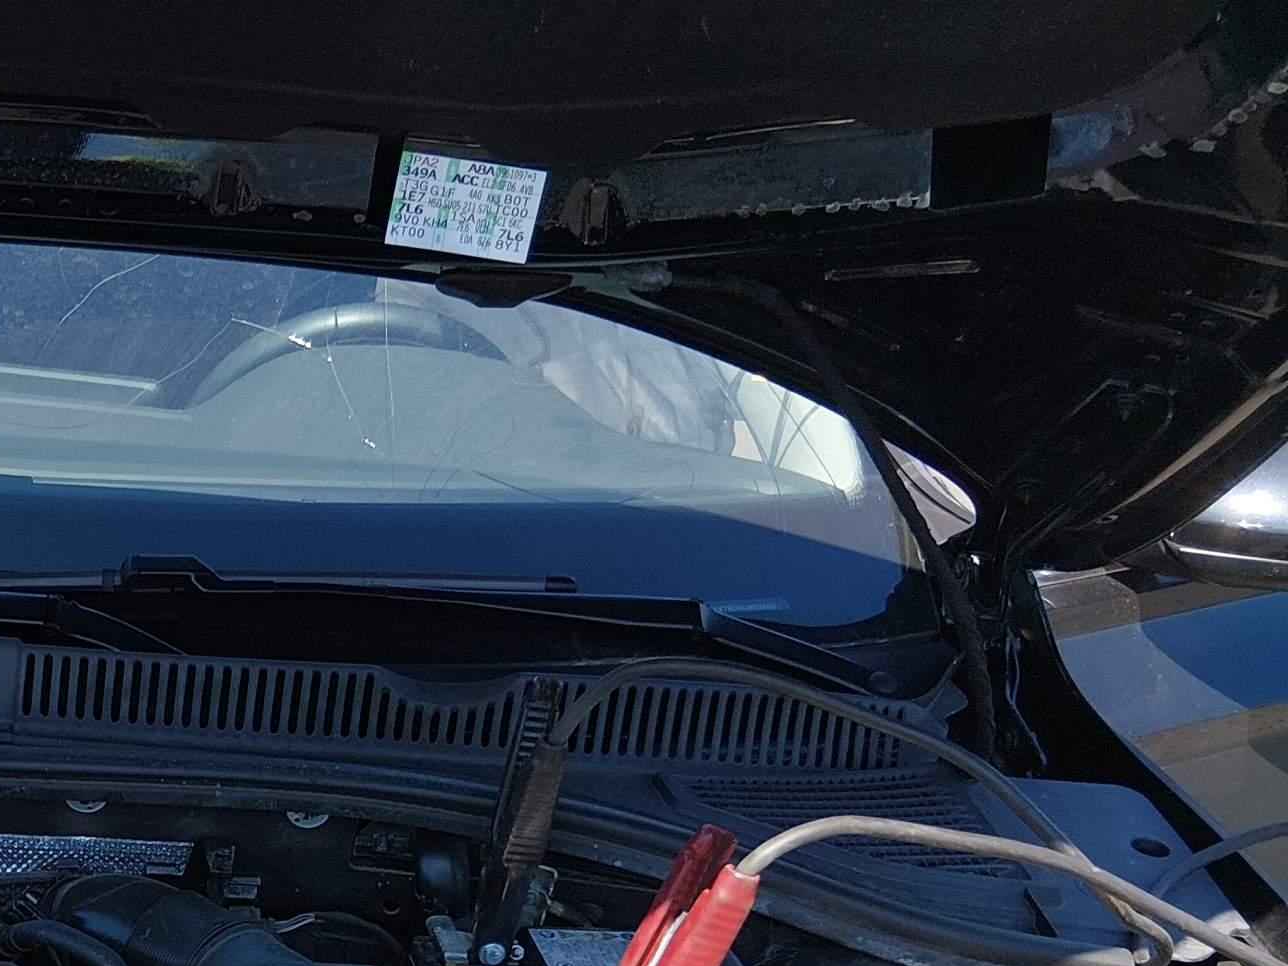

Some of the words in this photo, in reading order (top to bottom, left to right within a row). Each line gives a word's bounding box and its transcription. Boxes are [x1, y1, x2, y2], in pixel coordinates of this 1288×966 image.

[404, 154, 439, 167] JPA2
[402, 166, 438, 179] 349A
[452, 173, 479, 185] ACC
[403, 178, 428, 190] T3G
[401, 190, 426, 201] 1E7
[398, 202, 424, 214] 7L6
[451, 211, 476, 222] 1SA
[422, 216, 448, 228] KH4
[498, 229, 524, 240] 7L6
